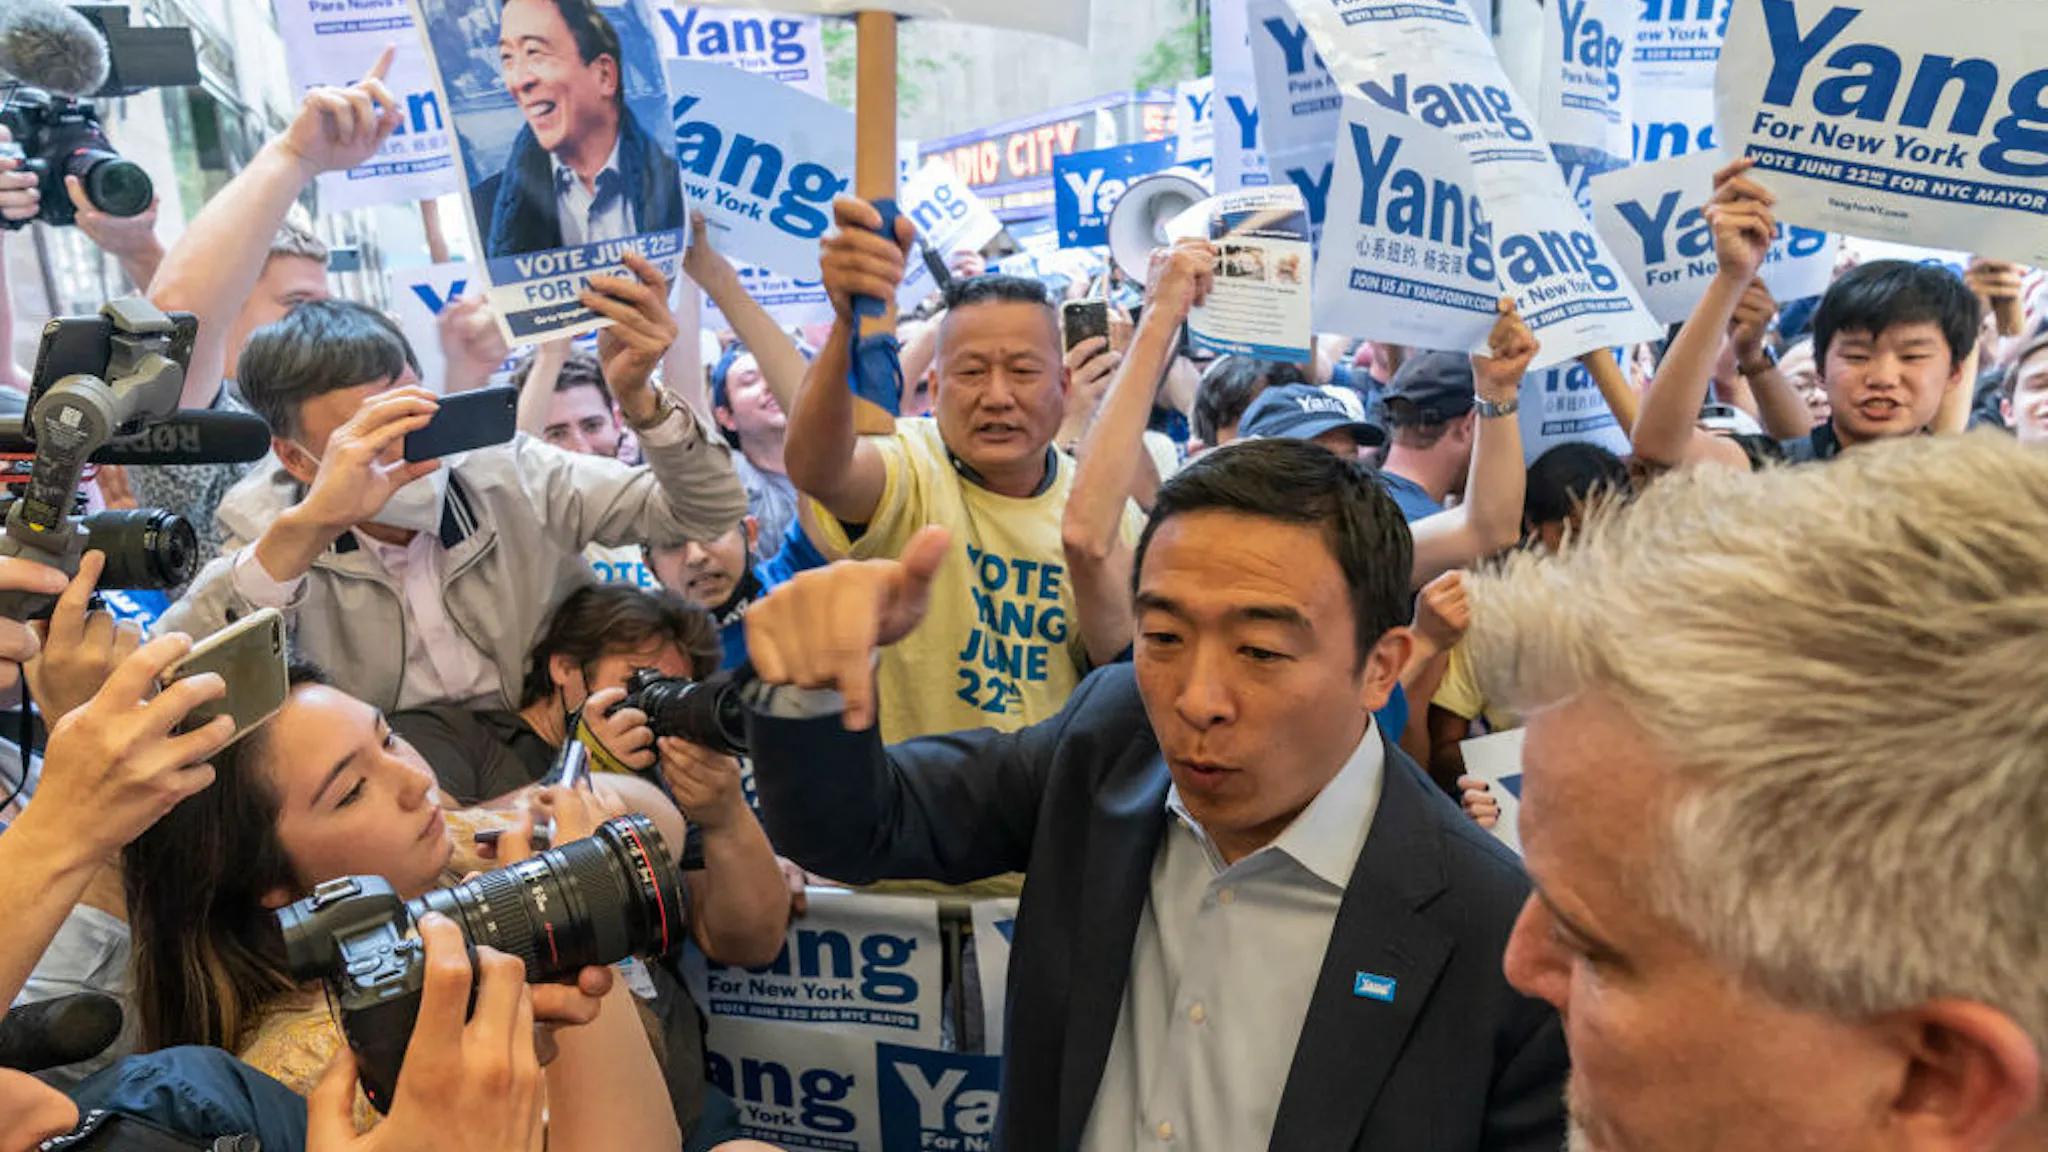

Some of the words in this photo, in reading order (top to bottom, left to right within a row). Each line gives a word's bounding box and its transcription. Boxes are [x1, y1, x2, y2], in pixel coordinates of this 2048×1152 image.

[659, 7, 807, 65] Yang
[1358, 73, 1533, 142] Yang
[1761, 0, 2048, 177] Yang
[673, 94, 849, 239] ang
[926, 140, 999, 186] DIO
[1007, 119, 1078, 178] CITY
[1751, 112, 1804, 142] For
[1810, 121, 1886, 156] New
[1894, 134, 1969, 171] York
[715, 187, 764, 221] York
[910, 184, 968, 232] ng
[1063, 168, 1137, 215] Ya
[1349, 121, 1496, 282] Yang
[1751, 150, 1795, 170] VOTE
[1798, 157, 1843, 179] JUNE
[1847, 166, 1886, 187] 22ND
[1890, 175, 1927, 195] FOR
[1931, 181, 1972, 200] NYC
[1976, 187, 2047, 212] MAYOR
[515, 247, 586, 278] VOTE
[592, 239, 648, 266] JUNE
[1352, 271, 1379, 290] JOIN
[1382, 277, 1399, 293] US
[1499, 229, 1618, 292] ang
[1646, 266, 1681, 287] For
[1688, 259, 1718, 279] Ne
[523, 278, 575, 303] FOR
[1529, 281, 1568, 305] New
[592, 560, 652, 587] OTE
[971, 586, 1067, 644] YANG
[959, 628, 1049, 681] JUNE
[706, 975, 741, 994] For
[749, 977, 798, 999] New
[803, 983, 855, 1001] York
[707, 929, 919, 1004] ng
[707, 1050, 857, 1133] ang
[748, 1105, 796, 1126] York
[892, 1060, 1000, 1134] Ya
[919, 1131, 960, 1149] For
